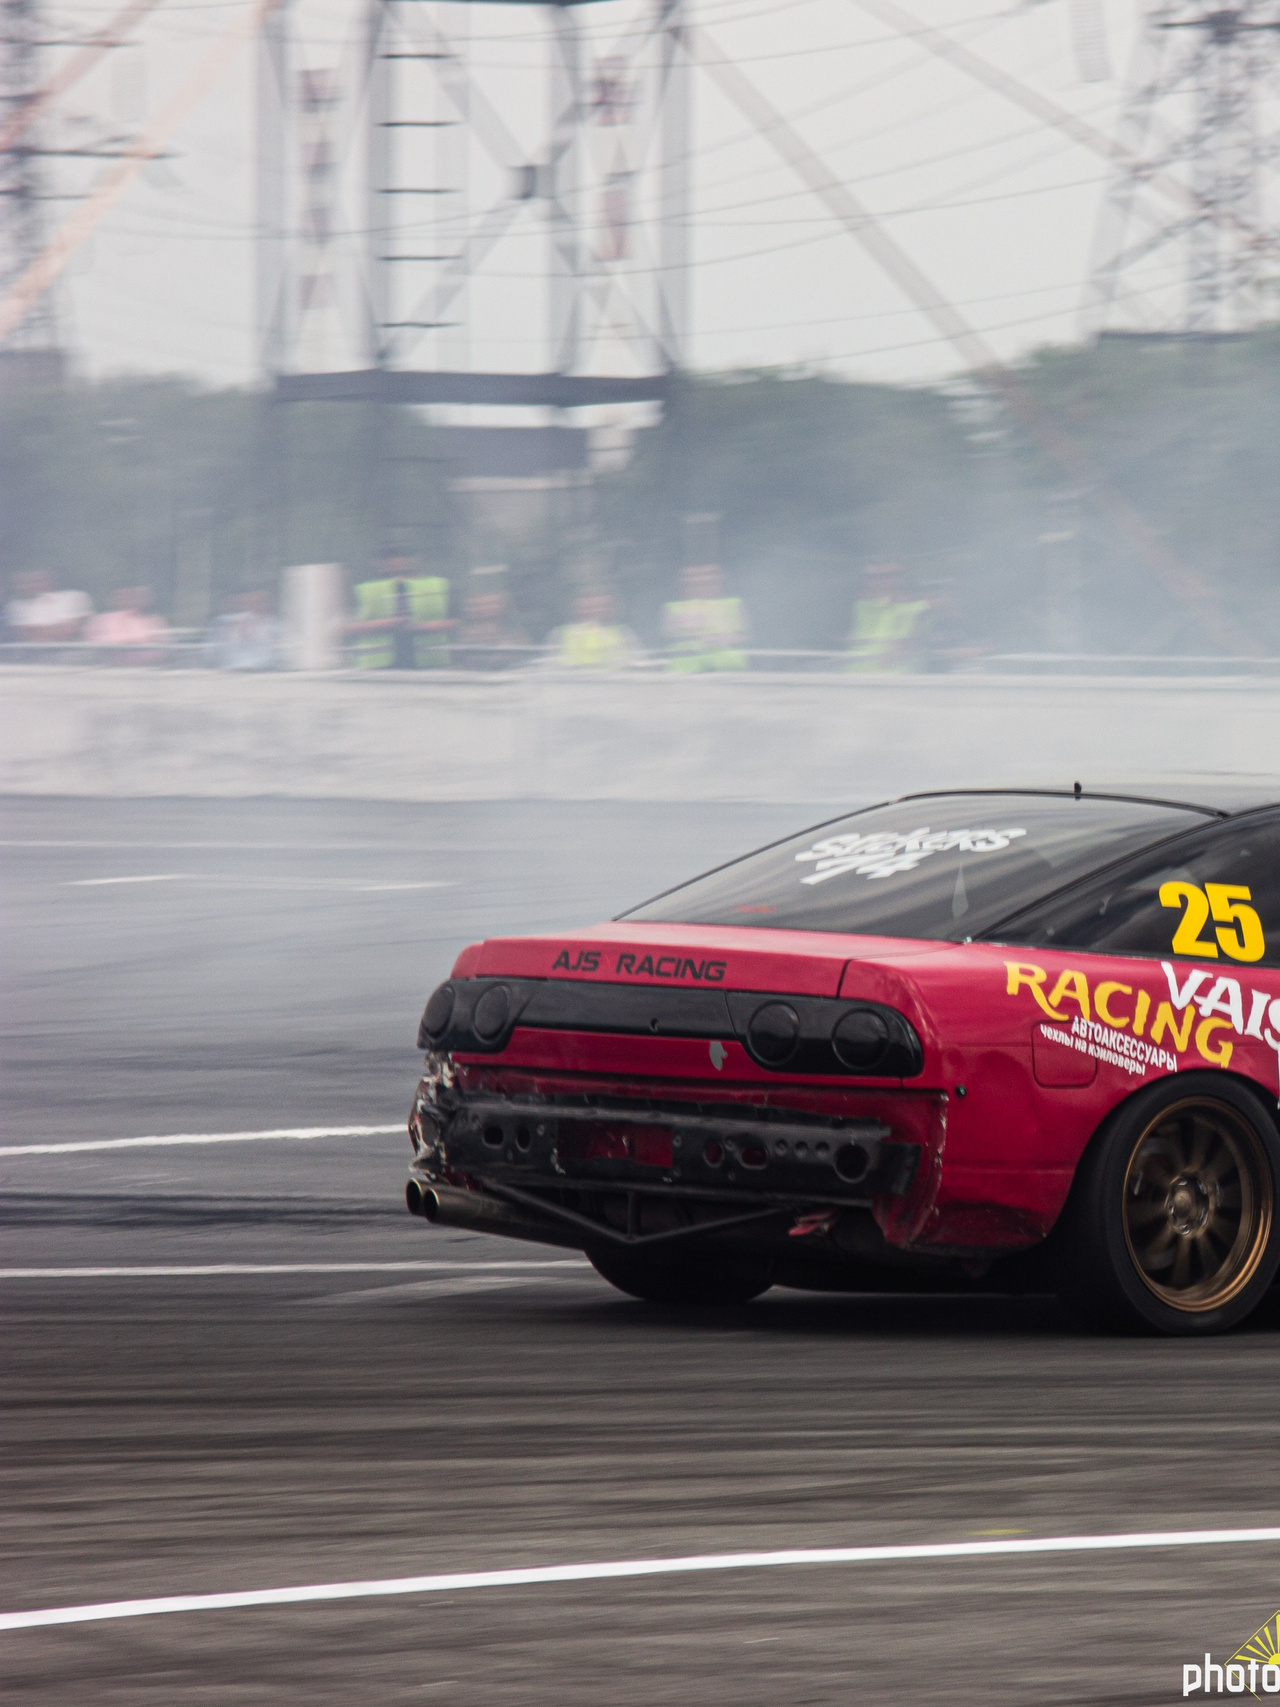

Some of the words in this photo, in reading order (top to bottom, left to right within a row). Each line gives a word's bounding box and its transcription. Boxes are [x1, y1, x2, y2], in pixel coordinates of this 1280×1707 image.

[1159, 881, 1265, 962] 25
[552, 950, 601, 972] AJS
[615, 953, 727, 982] RACING
[1003, 961, 1233, 1068] RACING
[1040, 1024, 1074, 1048] чехлы
[1074, 1036, 1087, 1053] на
[1071, 1015, 1178, 1072] АВТОАКСЕССУАРЫ
